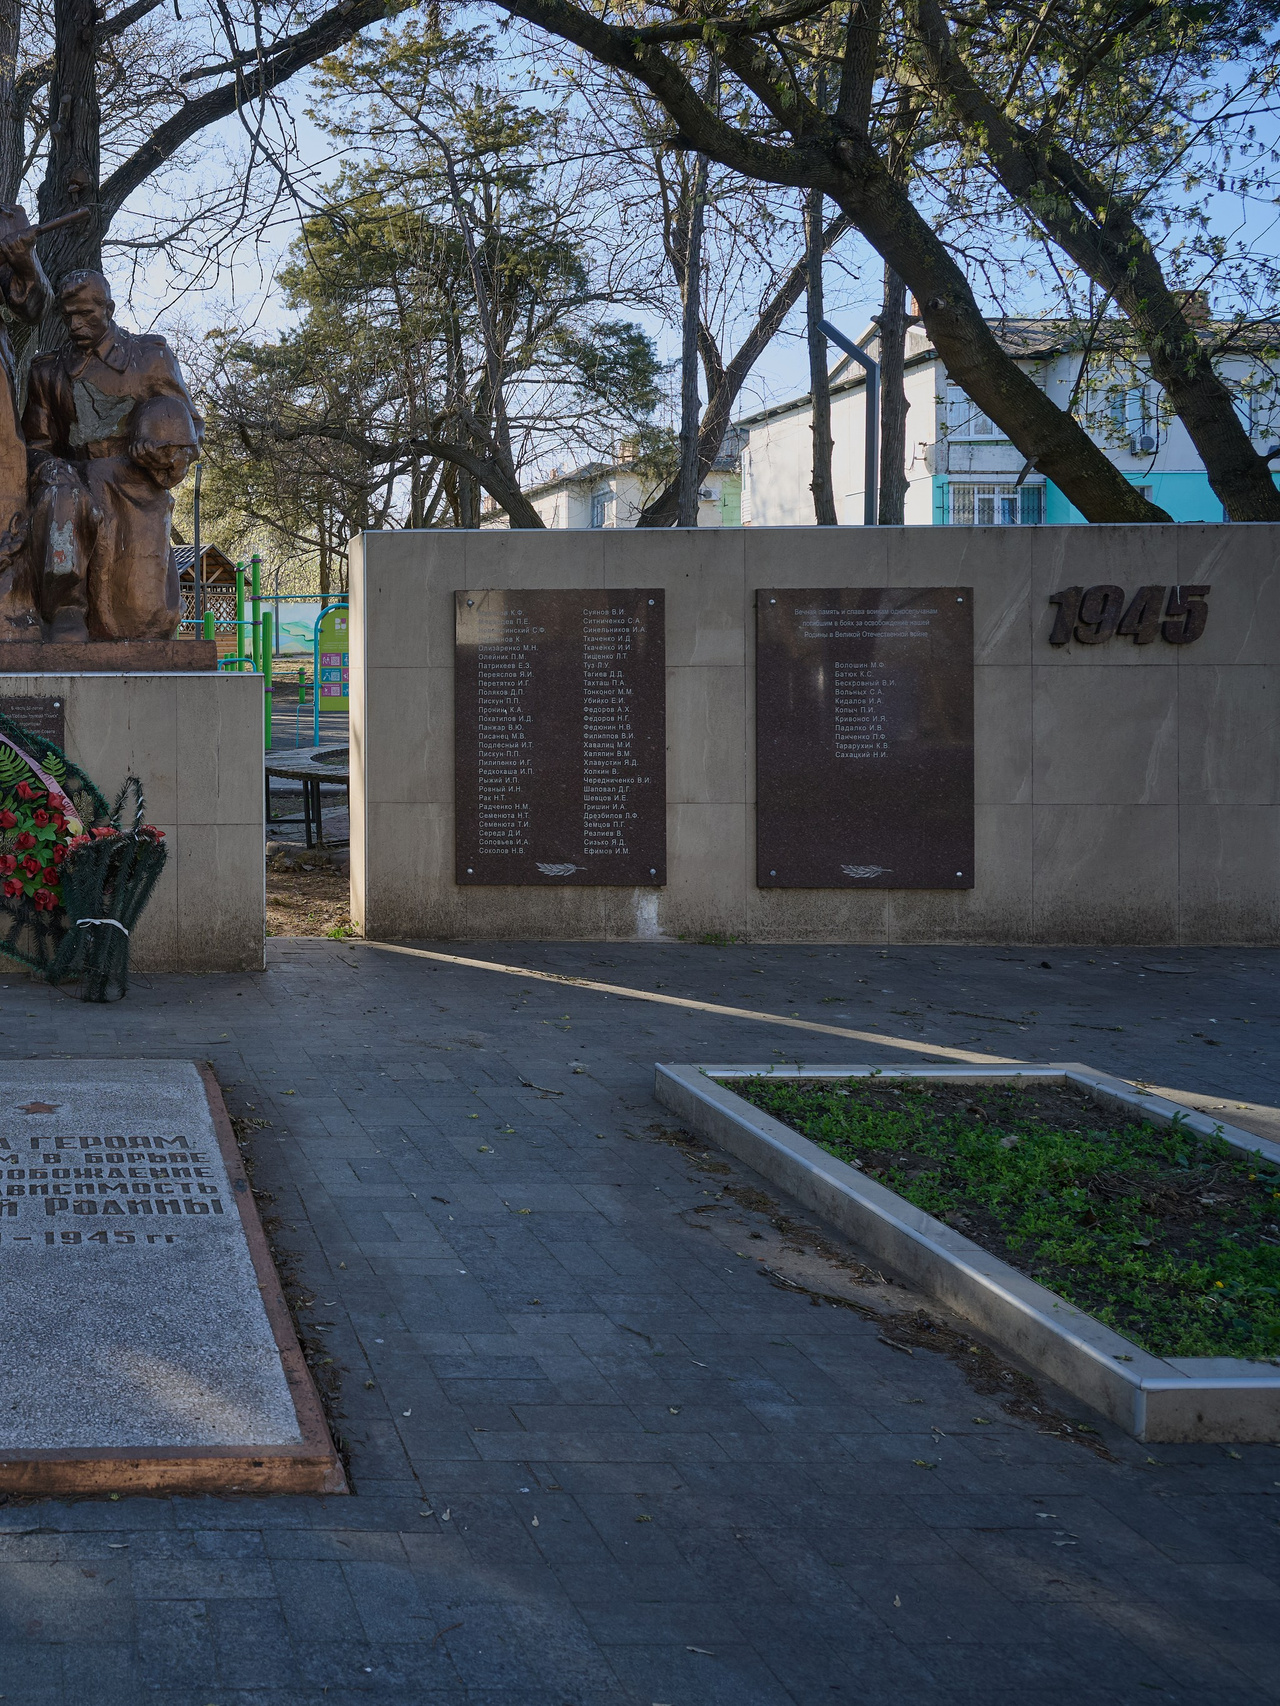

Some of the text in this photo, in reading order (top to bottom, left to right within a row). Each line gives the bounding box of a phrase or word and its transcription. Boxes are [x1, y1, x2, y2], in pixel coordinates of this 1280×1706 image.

[1048, 585, 1211, 646] 1945
[835, 742, 874, 750] Тарарухин
[479, 751, 504, 759] Пискун
[30, 1135, 190, 1150] ГЕРОЯМ
[43, 1153, 61, 1164] В
[85, 1152, 210, 1164] БОРЬБЕ
[45, 1198, 224, 1217] РОДИНЫ
[44, 1230, 136, 1245] 1945
